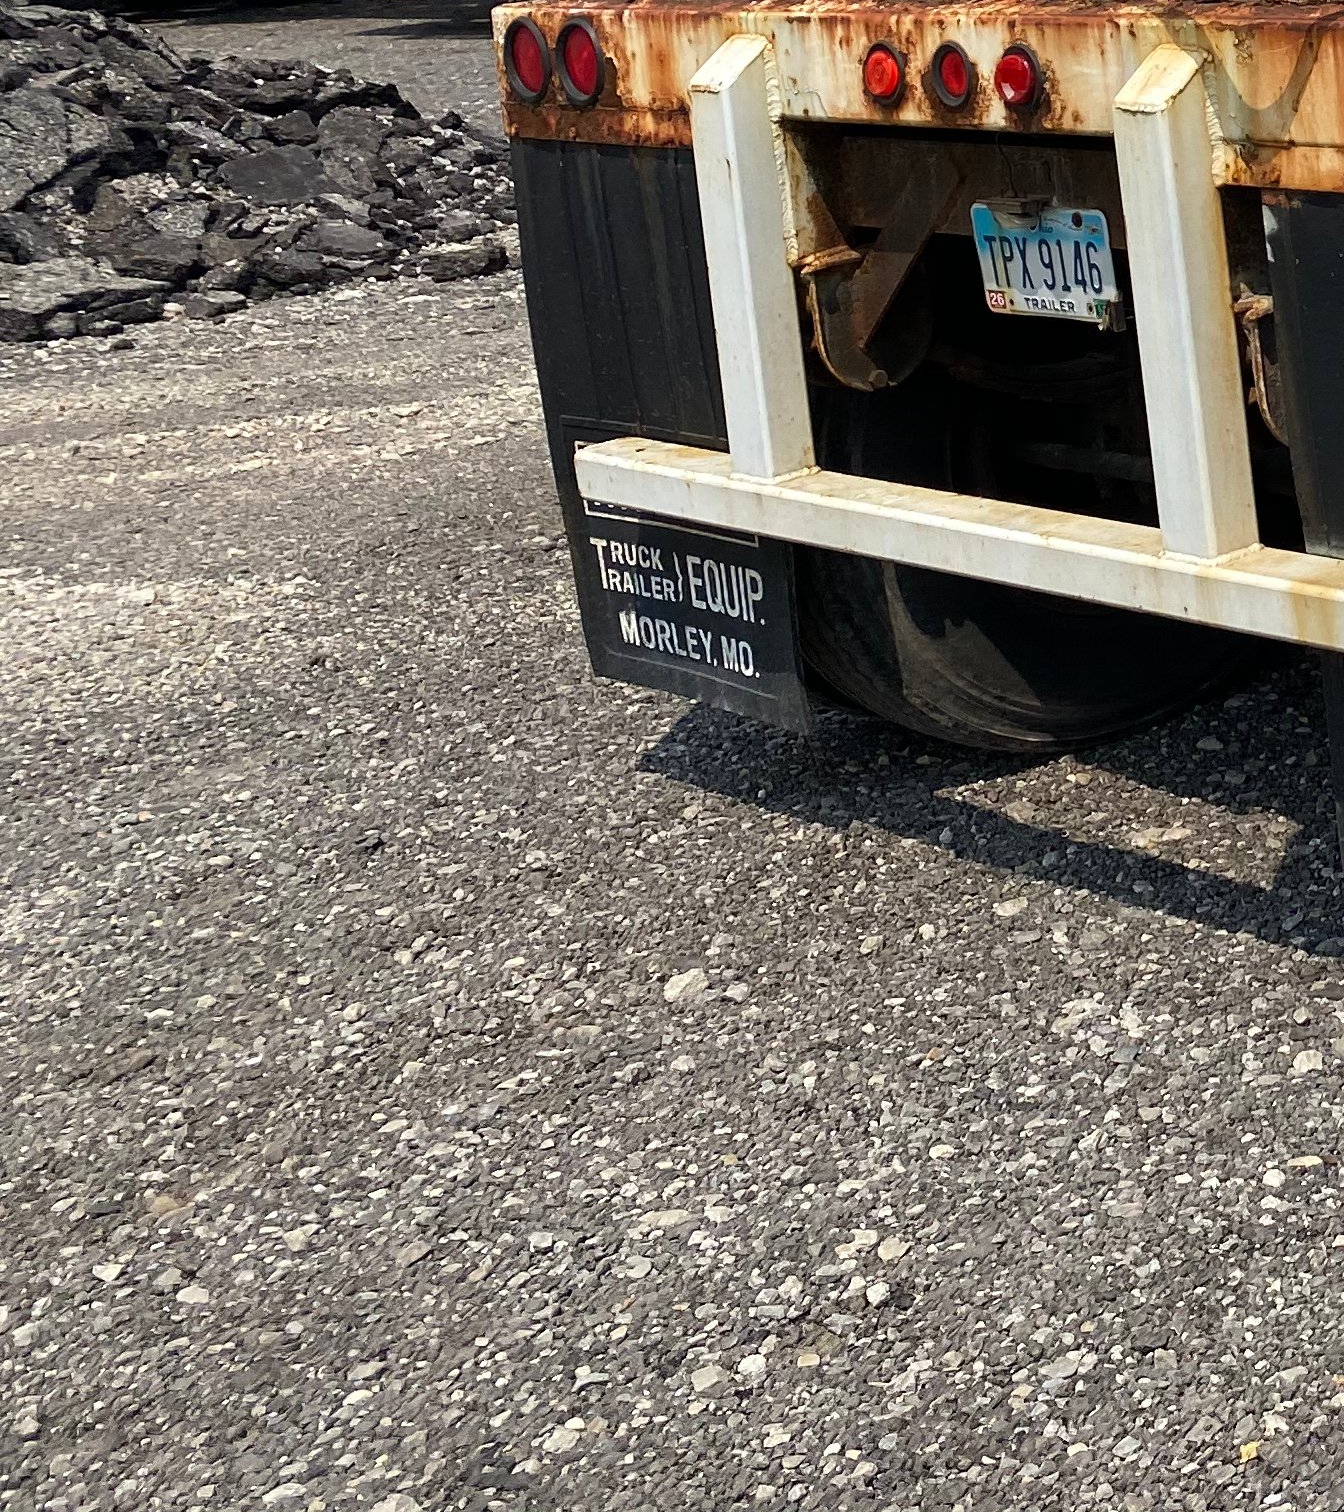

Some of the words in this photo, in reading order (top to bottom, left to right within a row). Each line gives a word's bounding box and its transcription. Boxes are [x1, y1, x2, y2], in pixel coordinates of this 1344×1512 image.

[983, 235, 1034, 289] TPX
[1038, 238, 1103, 294] 9146
[989, 292, 1005, 306] 26
[1023, 297, 1076, 314] TRAILER
[590, 537, 664, 587] TRUCK
[686, 554, 767, 626] EQUIP.
[618, 610, 718, 667] MORLEY,
[721, 635, 761, 678] MO.
